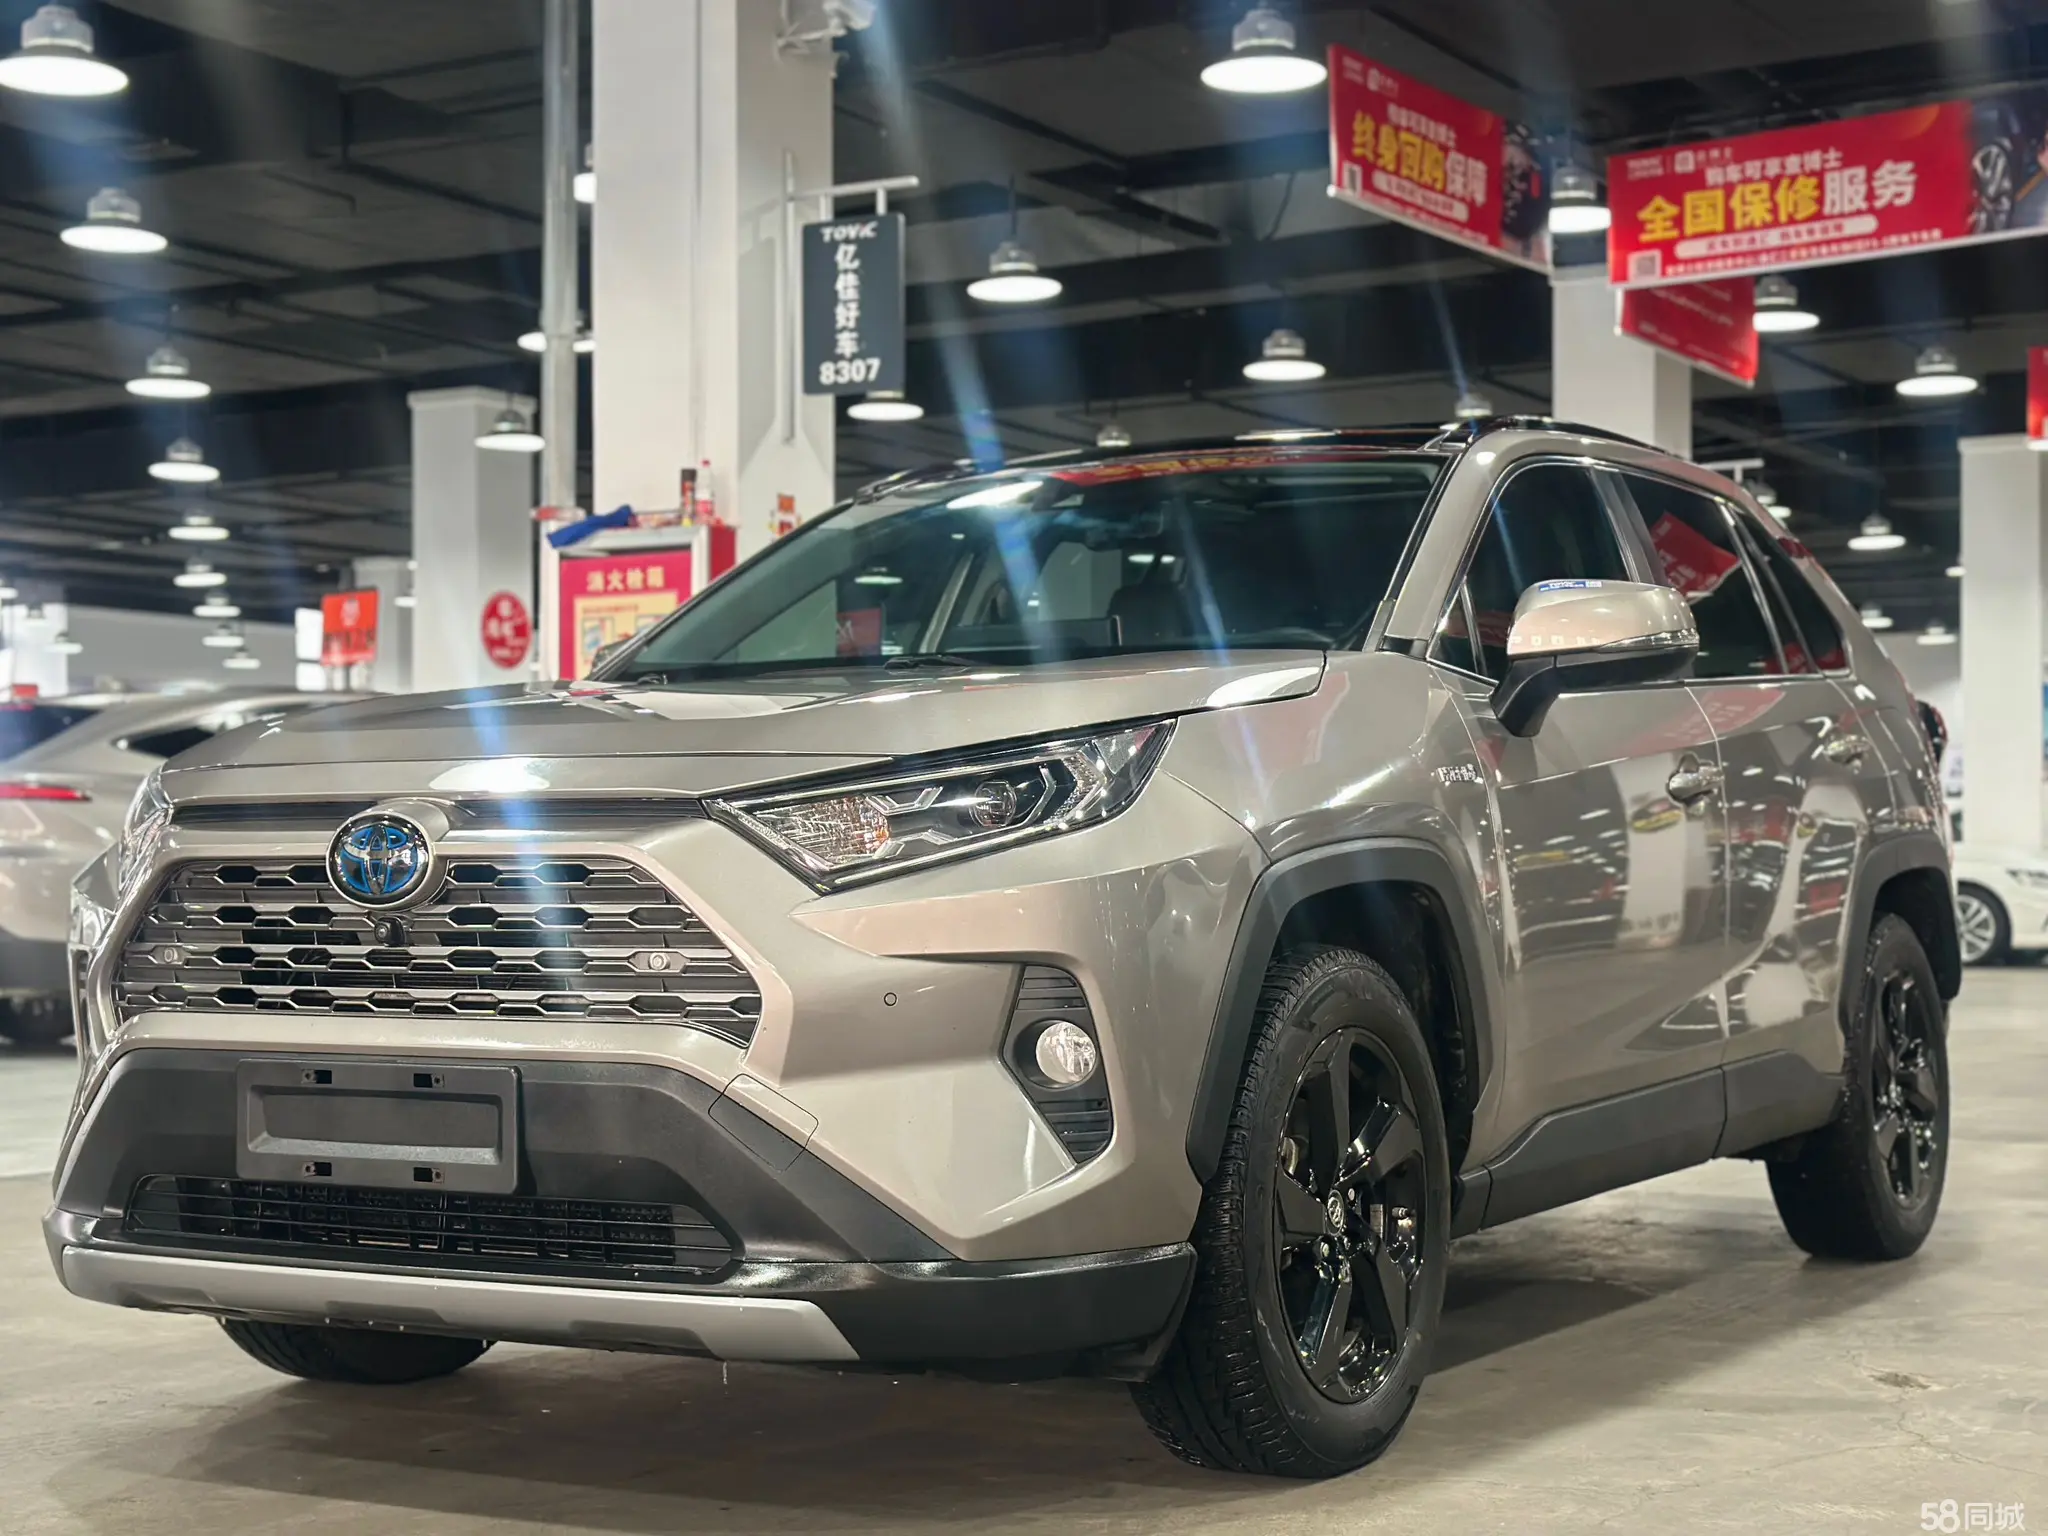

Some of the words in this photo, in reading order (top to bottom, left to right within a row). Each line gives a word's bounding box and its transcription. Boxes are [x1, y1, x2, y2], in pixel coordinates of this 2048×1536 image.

[1637, 160, 1917, 243] 全国保修服务
[819, 357, 881, 385] 8307
